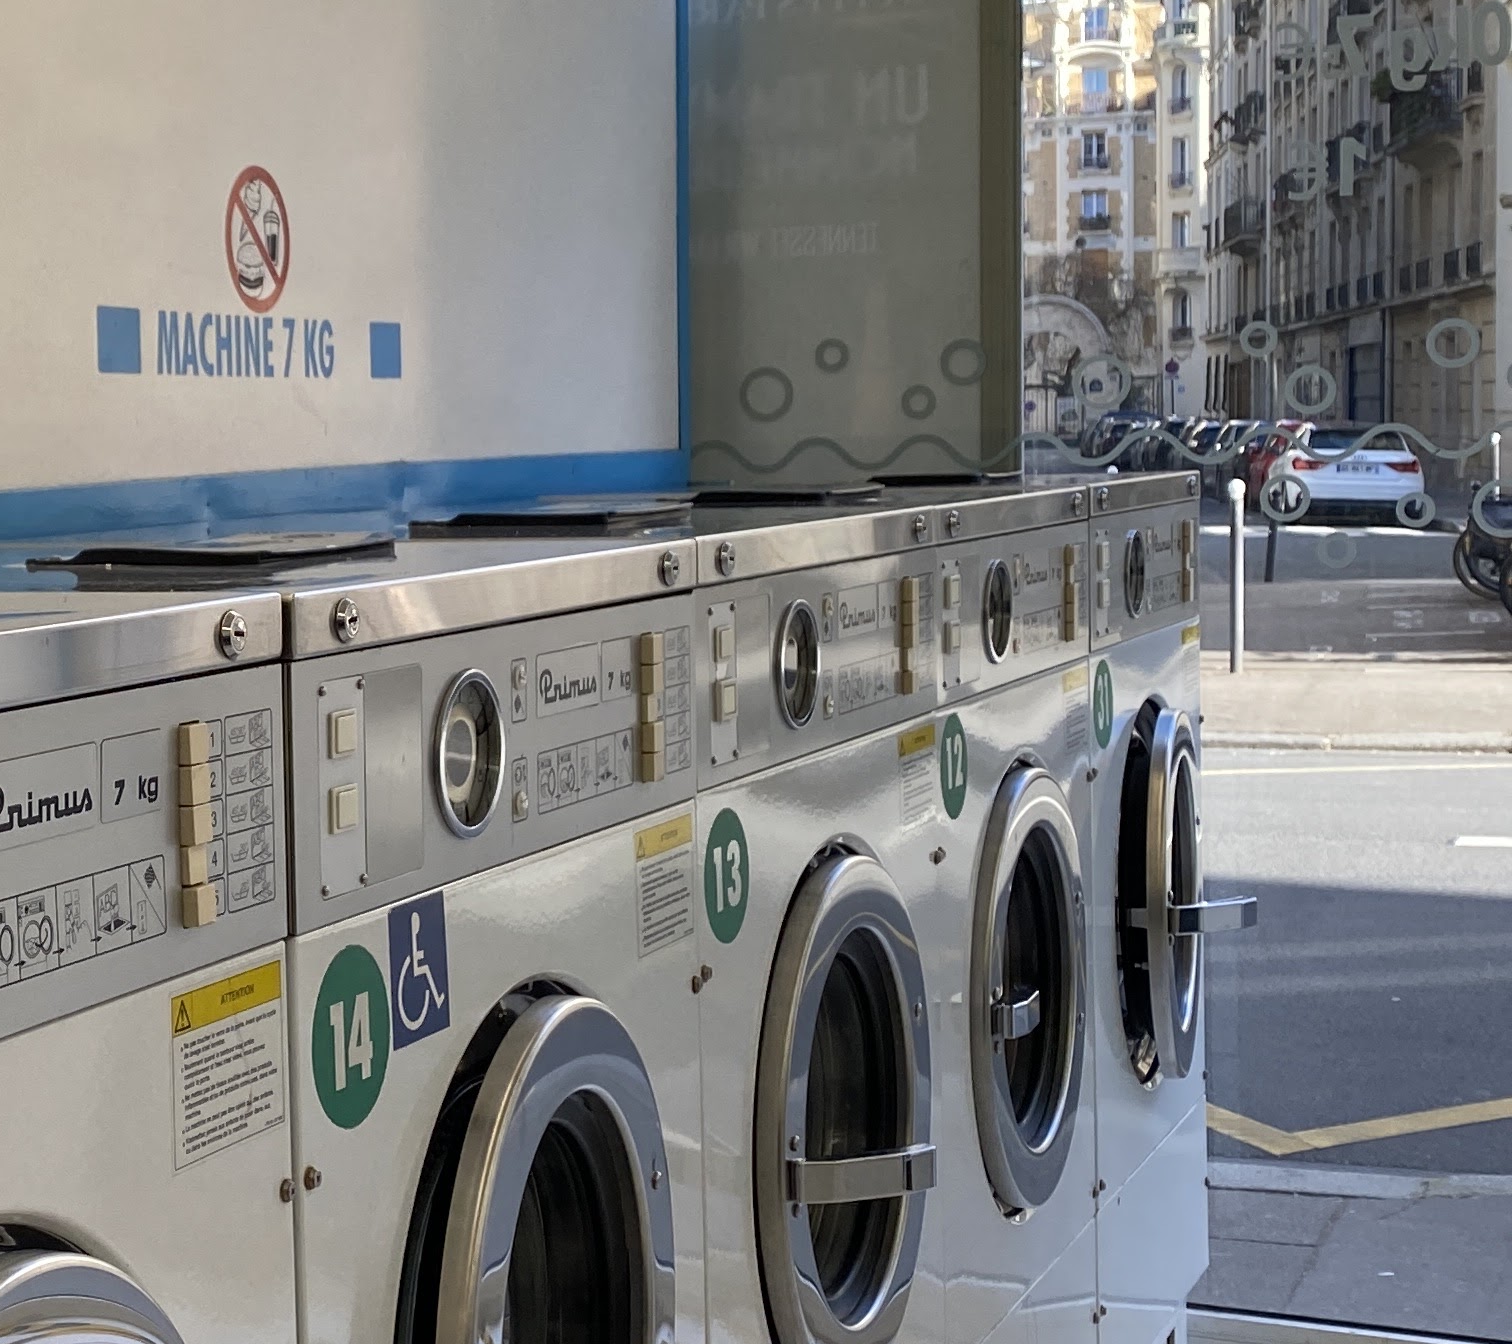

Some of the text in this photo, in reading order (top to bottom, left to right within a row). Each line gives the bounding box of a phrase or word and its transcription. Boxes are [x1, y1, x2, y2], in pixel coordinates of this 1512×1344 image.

[157, 310, 334, 378] MACHINE 7 KG
[540, 668, 631, 704] Primus 7 kg
[1097, 692, 1112, 725] 31
[114, 779, 125, 806] 7
[138, 774, 160, 804] kg
[945, 737, 964, 791] 12
[712, 838, 742, 914] 13
[329, 991, 374, 1092] 14
